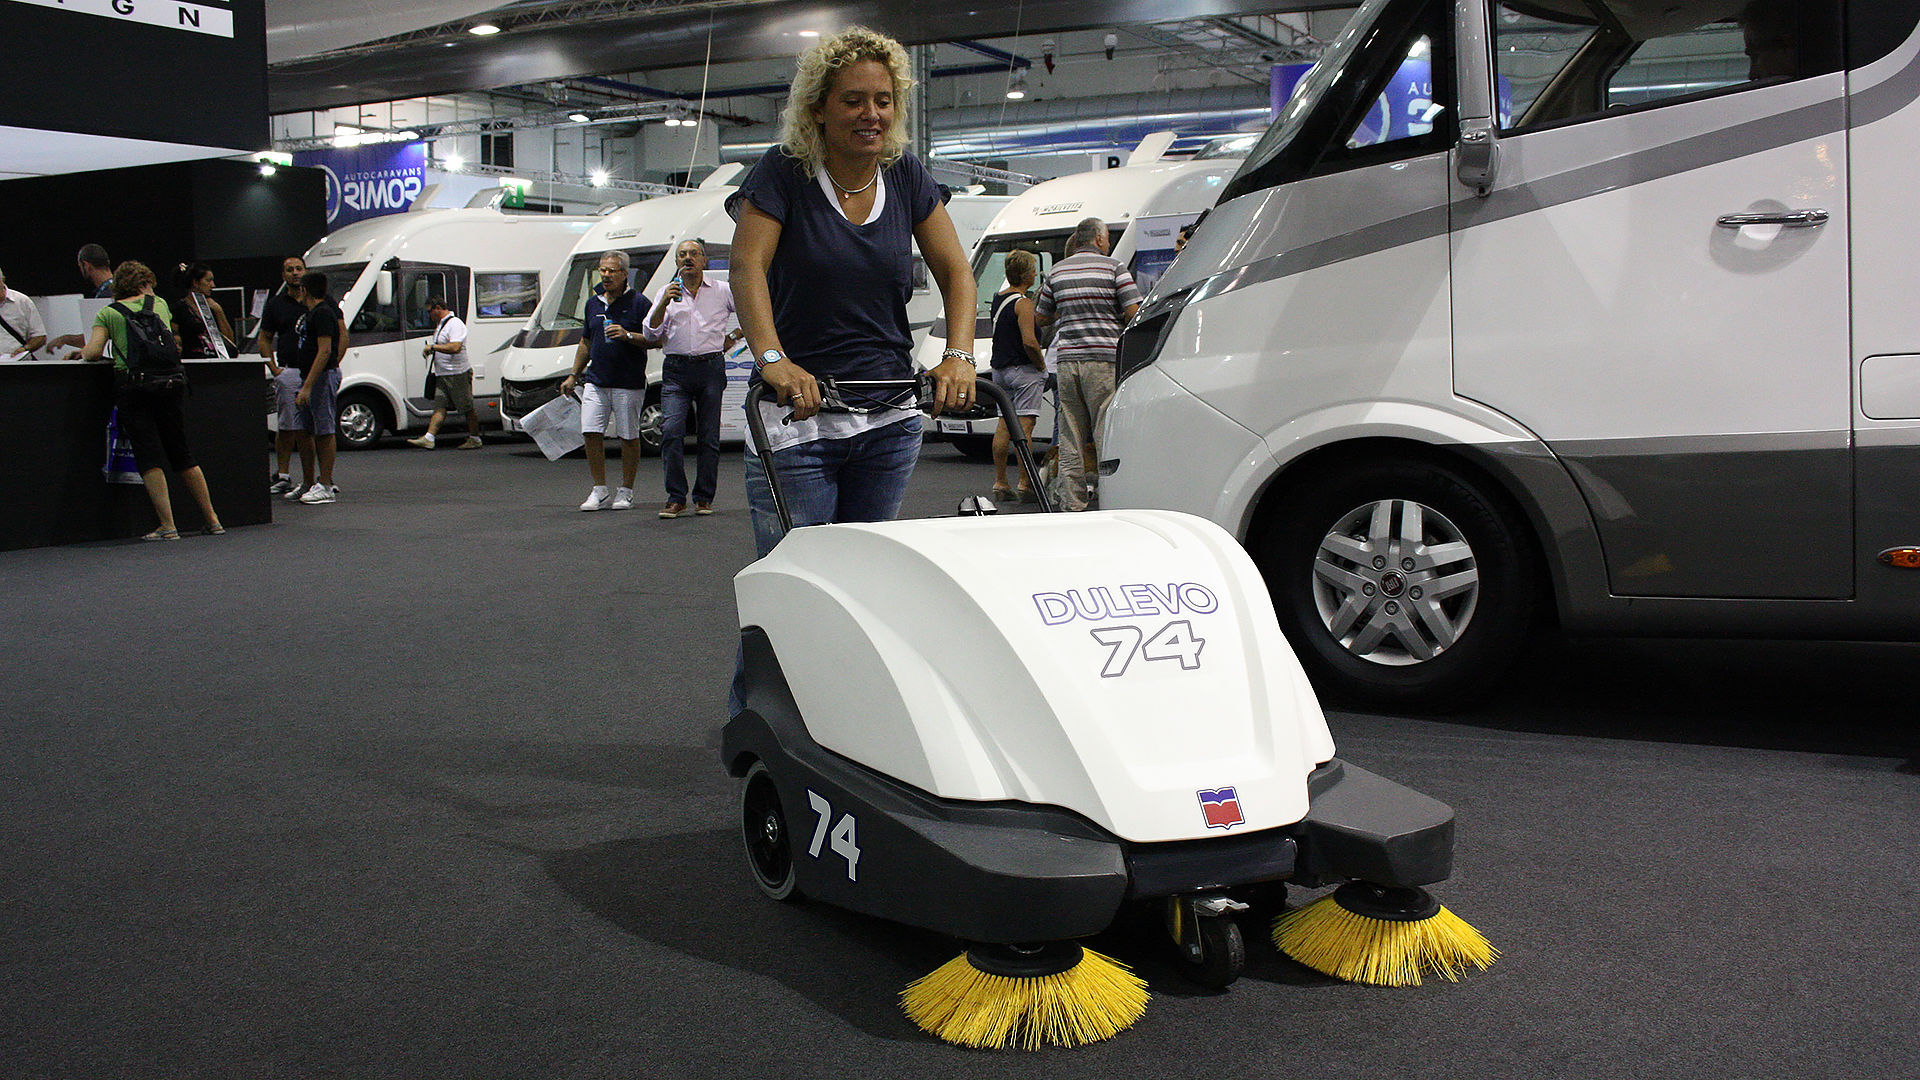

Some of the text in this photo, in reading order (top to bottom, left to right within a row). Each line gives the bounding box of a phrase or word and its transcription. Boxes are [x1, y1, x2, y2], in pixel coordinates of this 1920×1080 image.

[344, 167, 422, 181] AUTOCARAVANS
[344, 176, 422, 211] RIMOR
[1032, 582, 1219, 626] DULEVO
[1090, 619, 1206, 679] 74
[806, 788, 862, 883] 74
